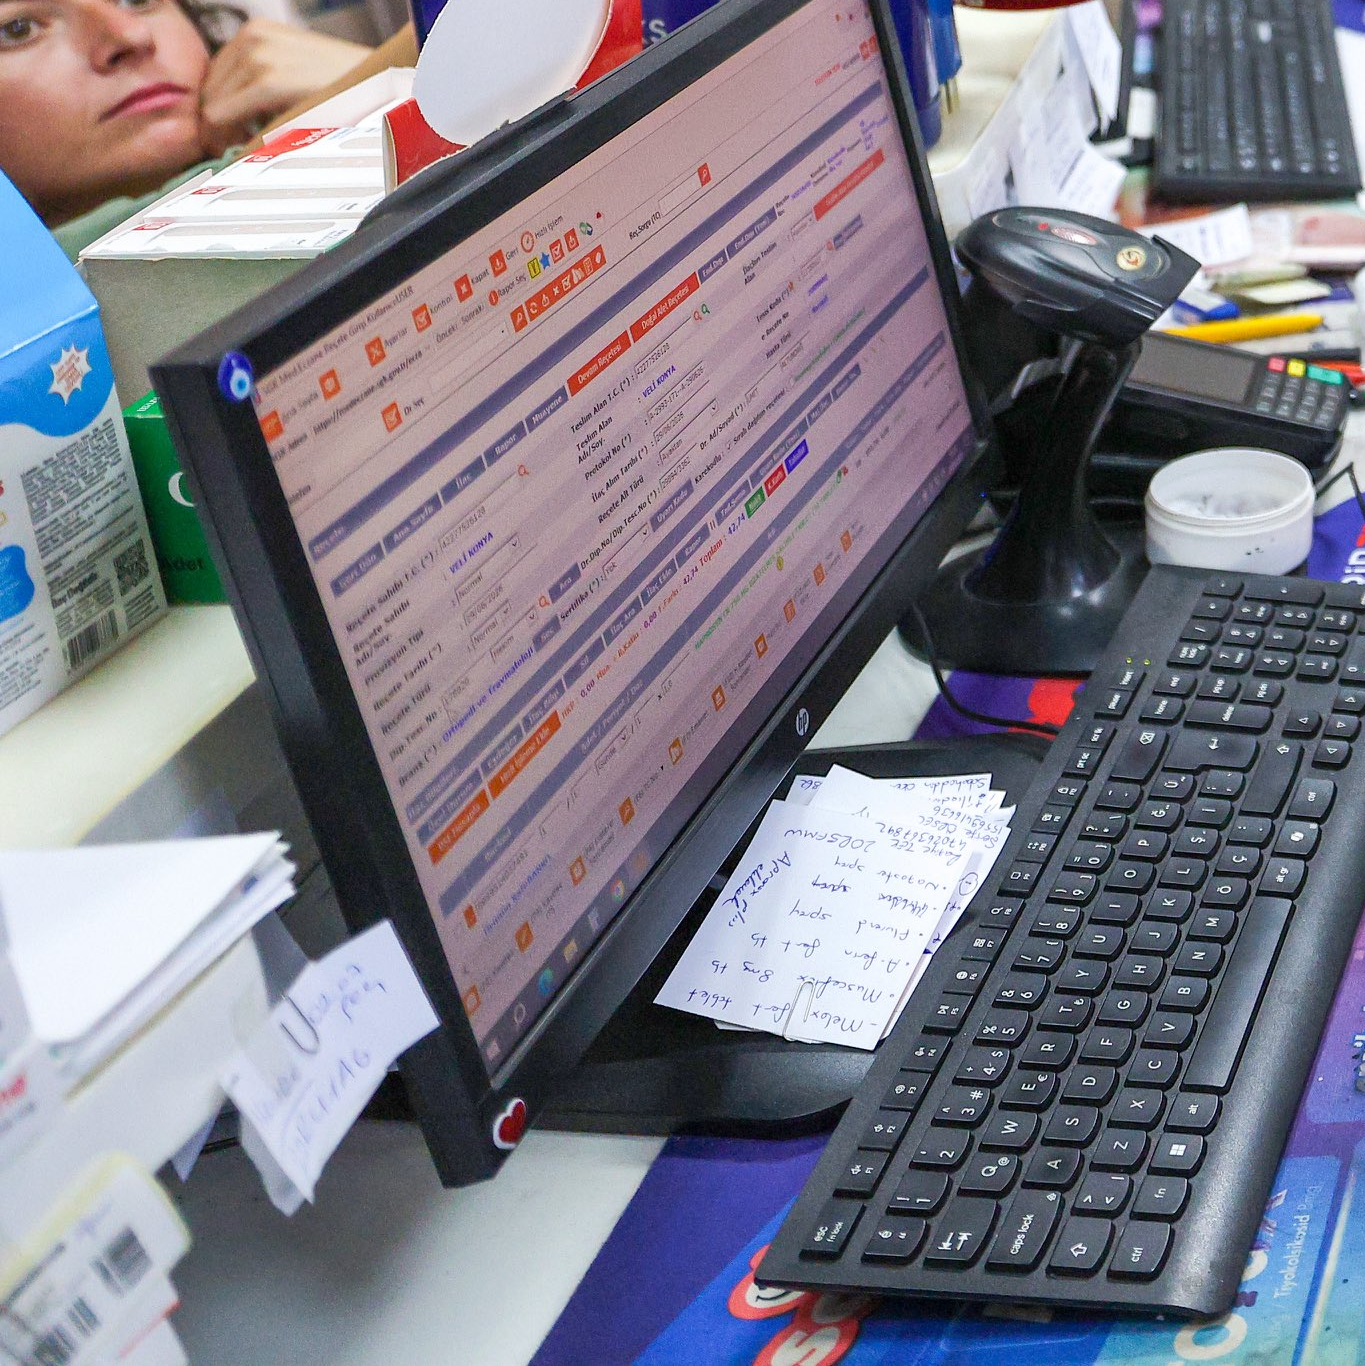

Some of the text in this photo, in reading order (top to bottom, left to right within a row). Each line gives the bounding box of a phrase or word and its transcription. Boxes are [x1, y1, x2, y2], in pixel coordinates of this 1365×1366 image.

[497, 278, 516, 300] Rapor
[641, 311, 657, 332] Doğal
[577, 360, 598, 385] Devam
[641, 362, 676, 399] VELİ KONYA
[531, 392, 562, 426] Muayene
[570, 412, 589, 435] Teslim
[588, 400, 602, 419] Alan
[596, 413, 613, 434] Alan
[584, 442, 621, 483] Protokol No
[727, 510, 746, 538] 42,74
[698, 535, 723, 570] Toplam
[1163, 780, 1180, 788] Ü
[1148, 808, 1167, 818] Ğ
[1137, 838, 1152, 846] P
[1189, 835, 1208, 844] Ş
[1230, 854, 1249, 863] Ç
[1122, 868, 1139, 878] O
[1214, 884, 1234, 894] Ö
[1161, 897, 1177, 906] K
[1205, 916, 1221, 927] M
[1091, 933, 1108, 943] U
[1147, 930, 1163, 939] J
[1190, 950, 1207, 961] N
[1074, 968, 1091, 978] Y
[1131, 963, 1148, 974] H
[1176, 985, 1192, 995] B
[1057, 1005, 1074, 1013] T
[1115, 999, 1133, 1010] G
[1160, 1021, 1178, 1032] V
[1039, 1042, 1057, 1051] R
[1099, 1037, 1115, 1046] F
[1145, 1059, 1163, 1070] C
[1020, 1081, 1038, 1091] E
[1080, 1075, 1099, 1086] D
[1128, 1098, 1147, 1109] X
[1000, 1118, 1021, 1135] W
[1063, 1116, 1081, 1126] S
[1112, 1139, 1130, 1151] Z
[1044, 1157, 1064, 1169] A
[979, 1164, 1000, 1177] Q
[811, 1224, 831, 1242] esc
